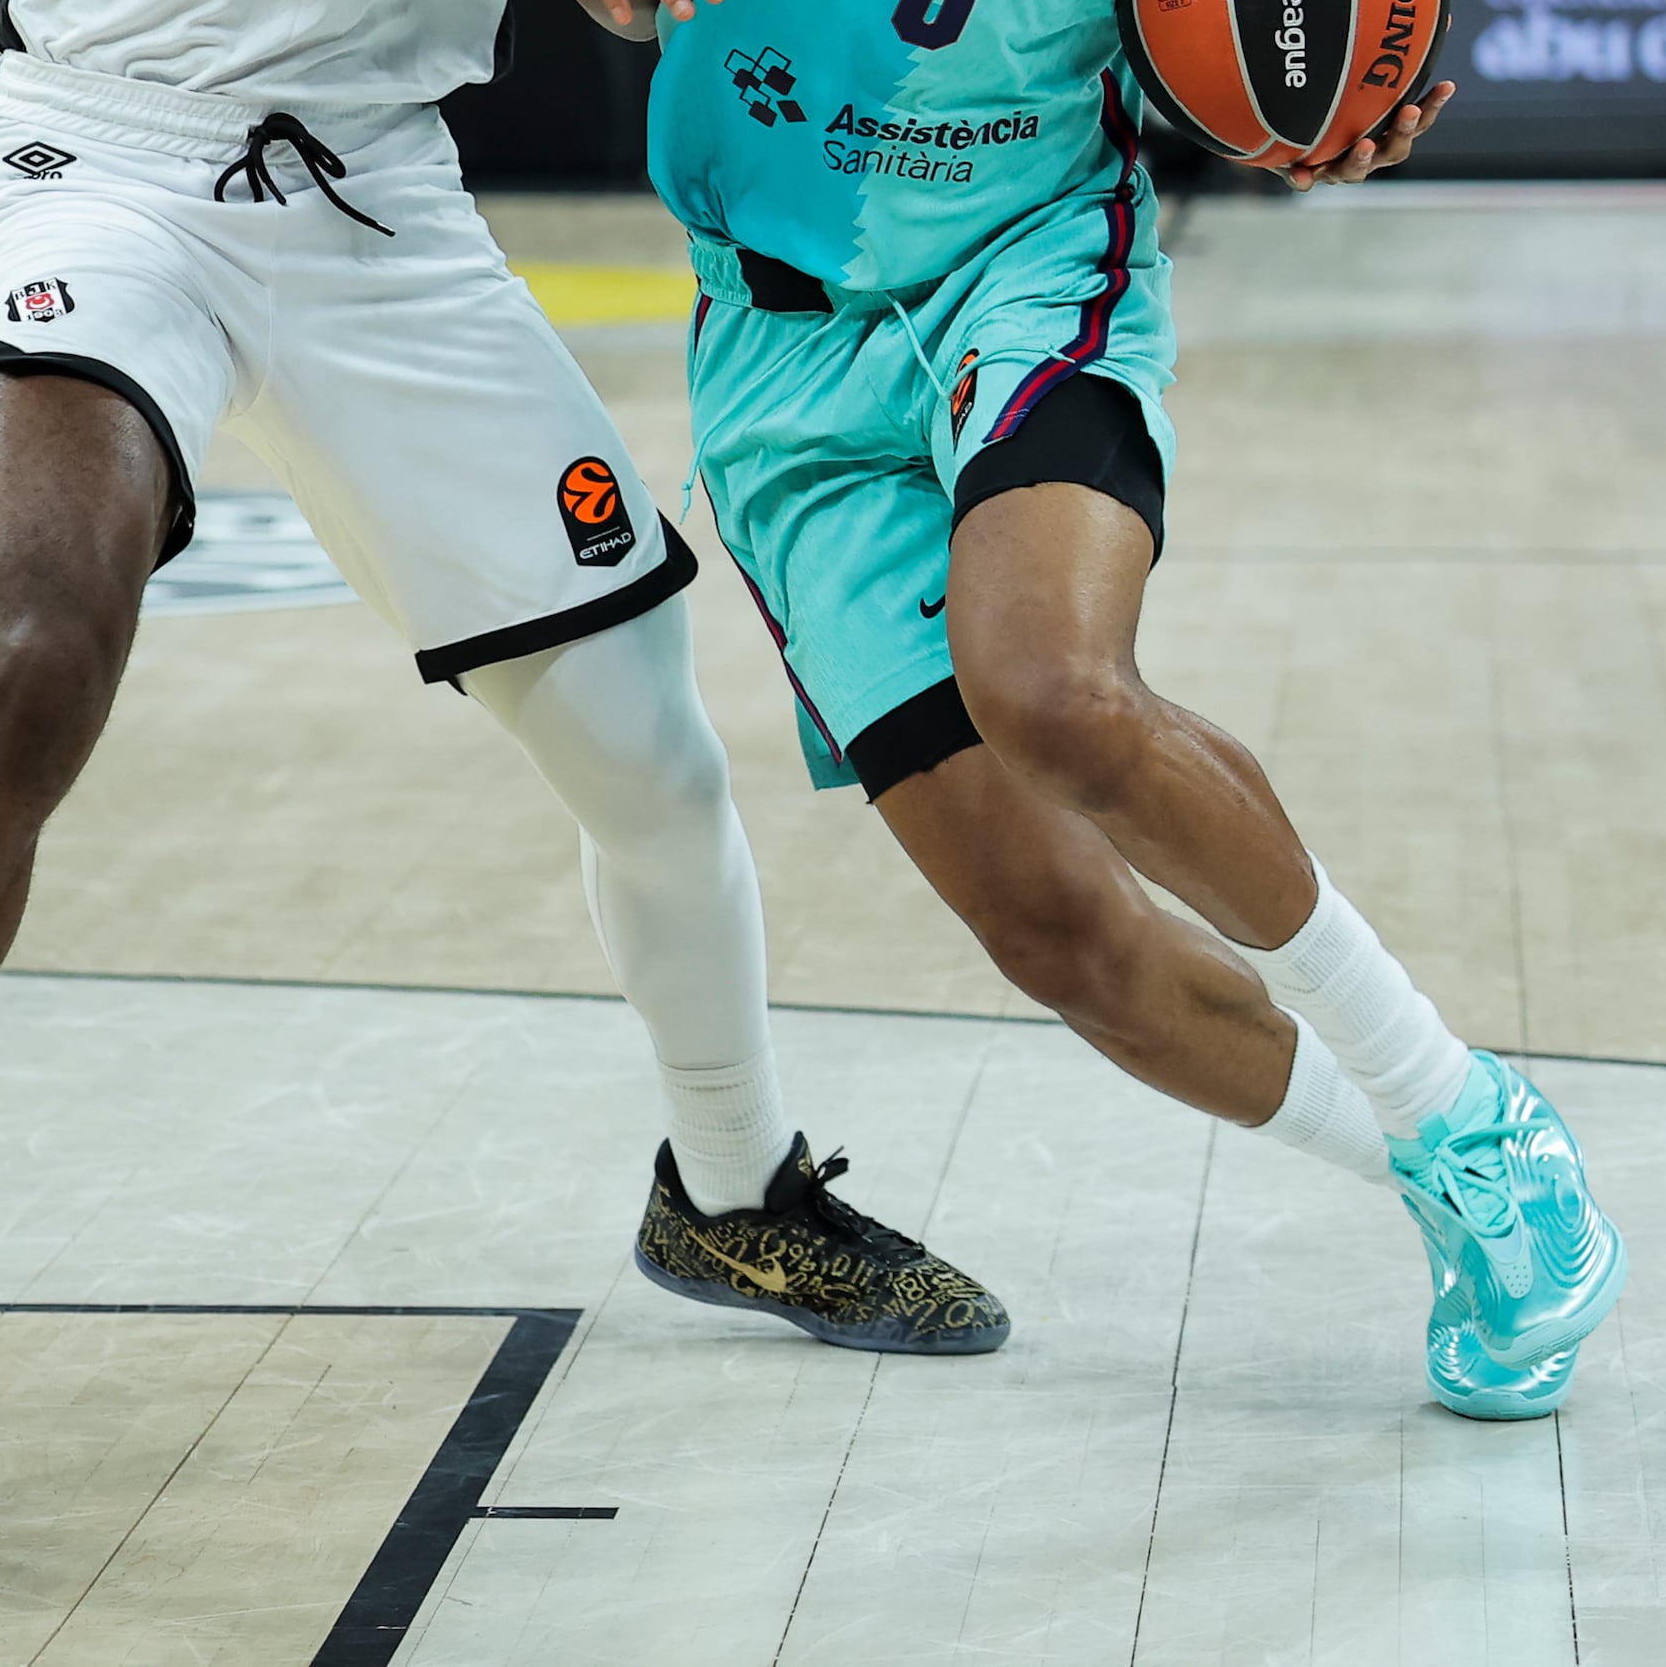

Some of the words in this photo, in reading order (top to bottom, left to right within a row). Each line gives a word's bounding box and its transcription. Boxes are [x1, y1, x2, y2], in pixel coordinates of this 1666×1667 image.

[825, 103, 1039, 150] Assistència
[823, 140, 974, 183] Sanitària
[579, 532, 632, 559] ETIHAD
